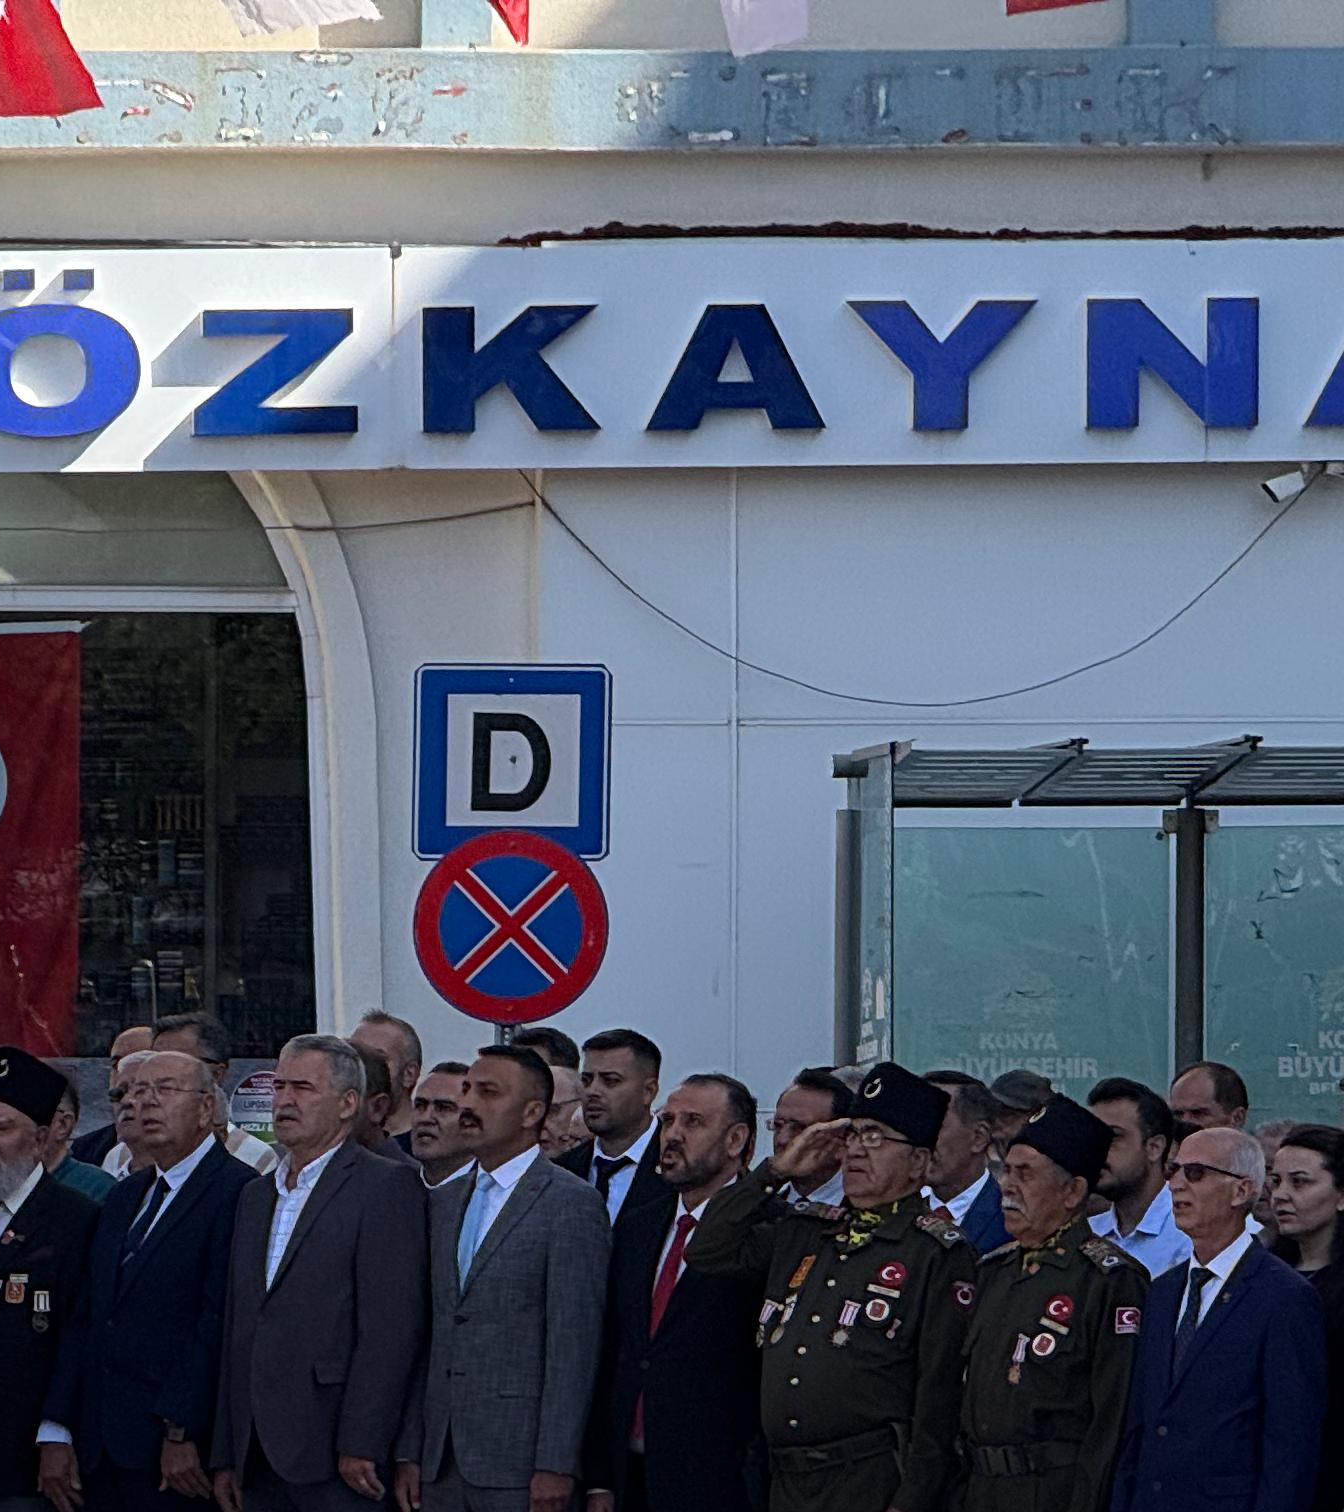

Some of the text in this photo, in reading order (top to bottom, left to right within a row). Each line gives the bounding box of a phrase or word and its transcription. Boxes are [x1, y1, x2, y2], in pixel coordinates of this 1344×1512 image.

[471, 712, 552, 812] D
[979, 1032, 1058, 1051] KONYA
[1318, 1030, 1344, 1049] KO
[1277, 1051, 1344, 1078] BÜYÜ
